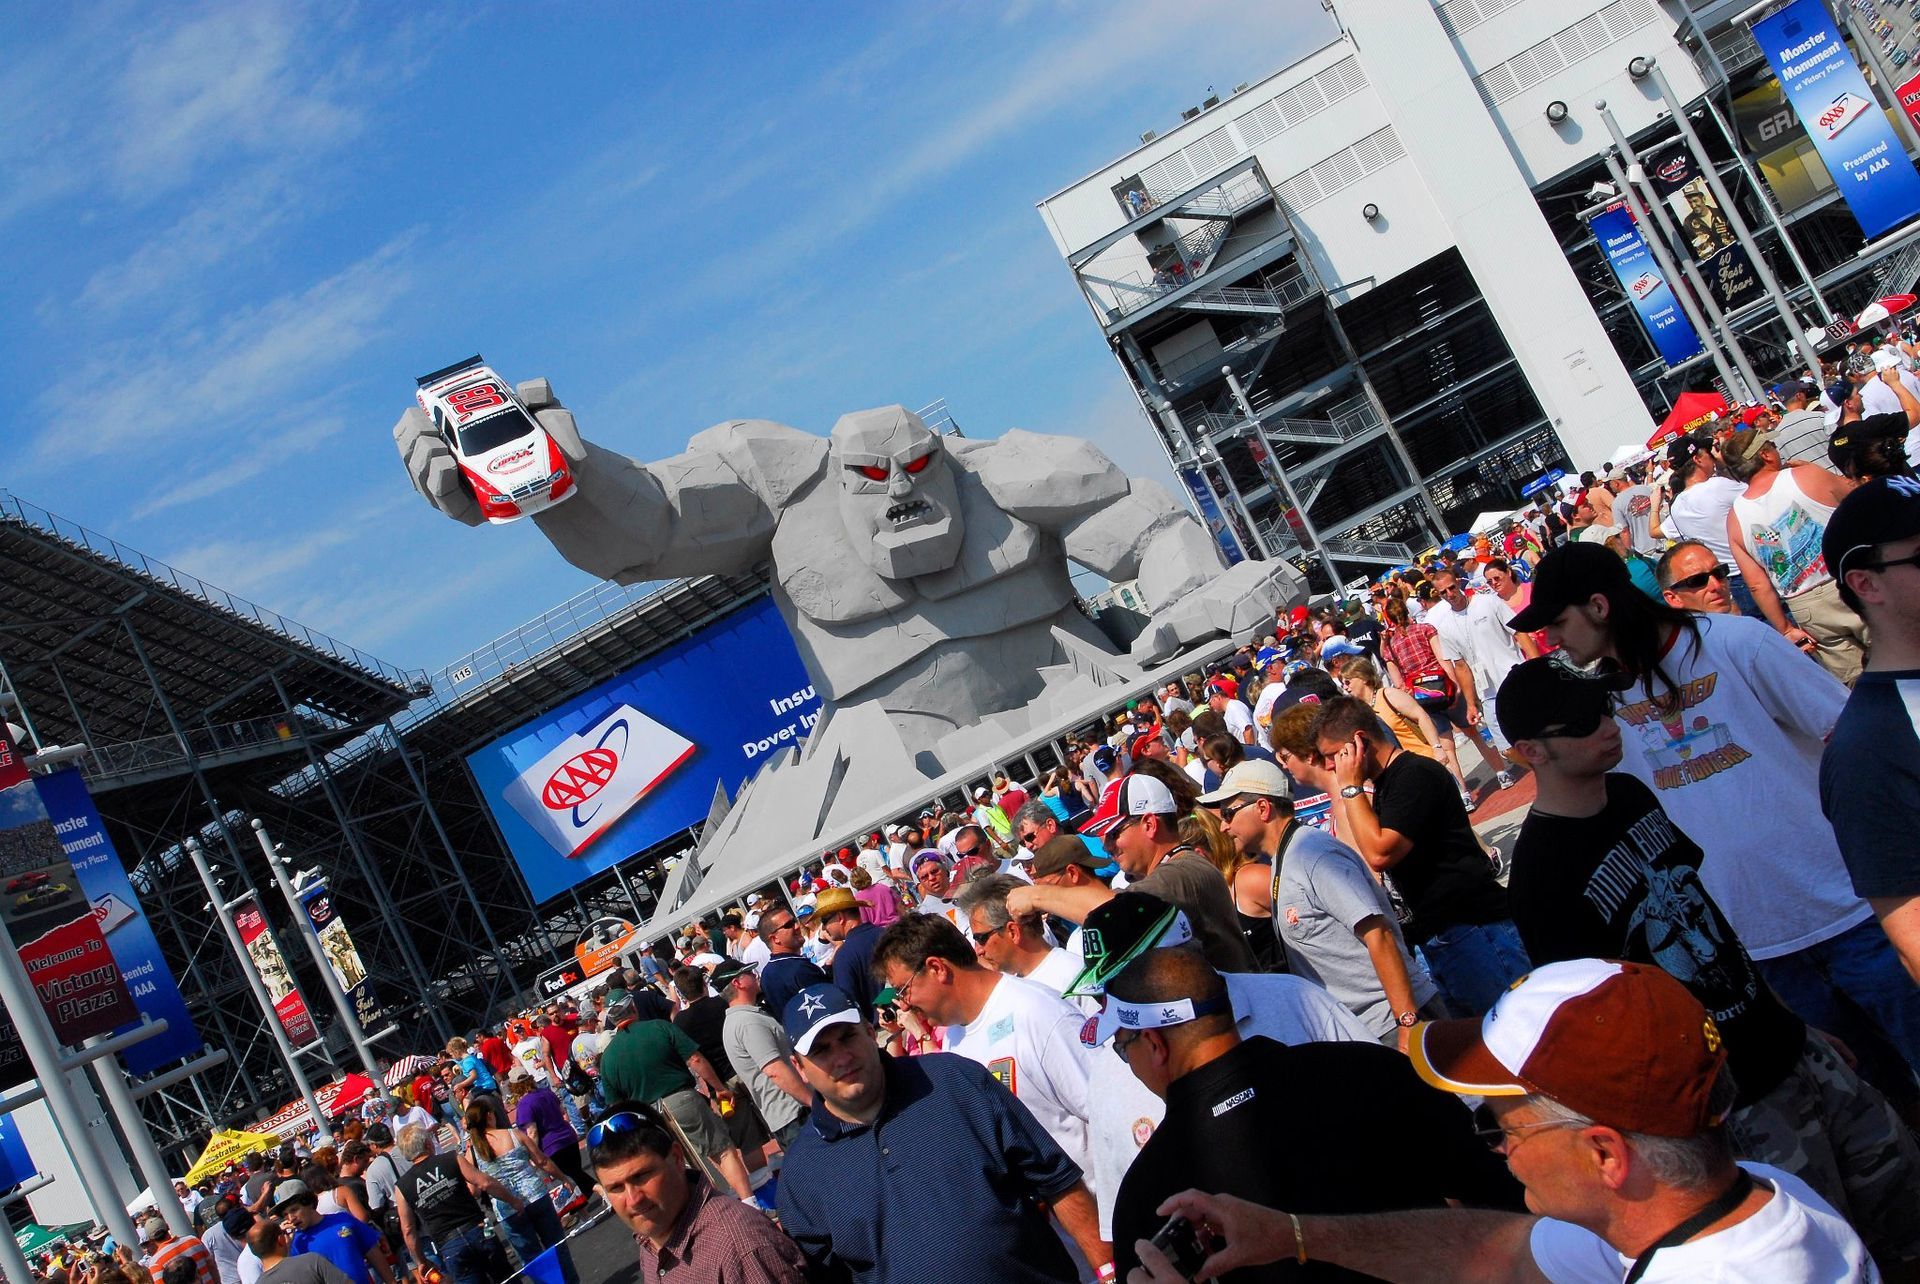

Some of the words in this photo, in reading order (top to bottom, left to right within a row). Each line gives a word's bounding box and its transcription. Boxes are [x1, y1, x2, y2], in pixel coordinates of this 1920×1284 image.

[1780, 31, 1826, 63] Monster
[1782, 41, 1841, 81] Monument
[1802, 70, 1826, 86] Victory
[1826, 60, 1845, 73] Plaza
[1820, 106, 1844, 126] AAA
[1843, 141, 1888, 171] Presented
[1855, 170, 1868, 182] by
[1869, 158, 1890, 173] AAA
[1607, 232, 1633, 248] Monster
[1609, 240, 1642, 259] Monument
[1719, 252, 1732, 266] 40
[1718, 263, 1744, 283] Fast
[1722, 275, 1754, 301] Years
[1649, 305, 1674, 321] Presented
[1683, 411, 1713, 432] SUNGLAS
[453, 667, 472, 682] 115
[769, 685, 816, 716] Insu
[742, 724, 797, 759] Dover
[546, 750, 618, 809] AAA
[1294, 797, 1319, 809] ATIONAL
[54, 816, 88, 835] nster
[62, 831, 104, 854] ument
[72, 860, 88, 871] tory
[88, 854, 108, 866] Plaza
[27, 946, 84, 973] Welcome
[86, 940, 102, 953] To
[122, 960, 155, 982] sented
[544, 971, 577, 993] FedEx
[37, 963, 118, 1003] Victory
[134, 980, 157, 998] AAA
[57, 989, 118, 1024] Plaza
[359, 1008, 381, 1029] Years
[320, 1085, 343, 1101] CA
[1223, 1088, 1255, 1111] NASCAR
[194, 1157, 236, 1182] SUBSCRE
[416, 1166, 445, 1194] A.V.
